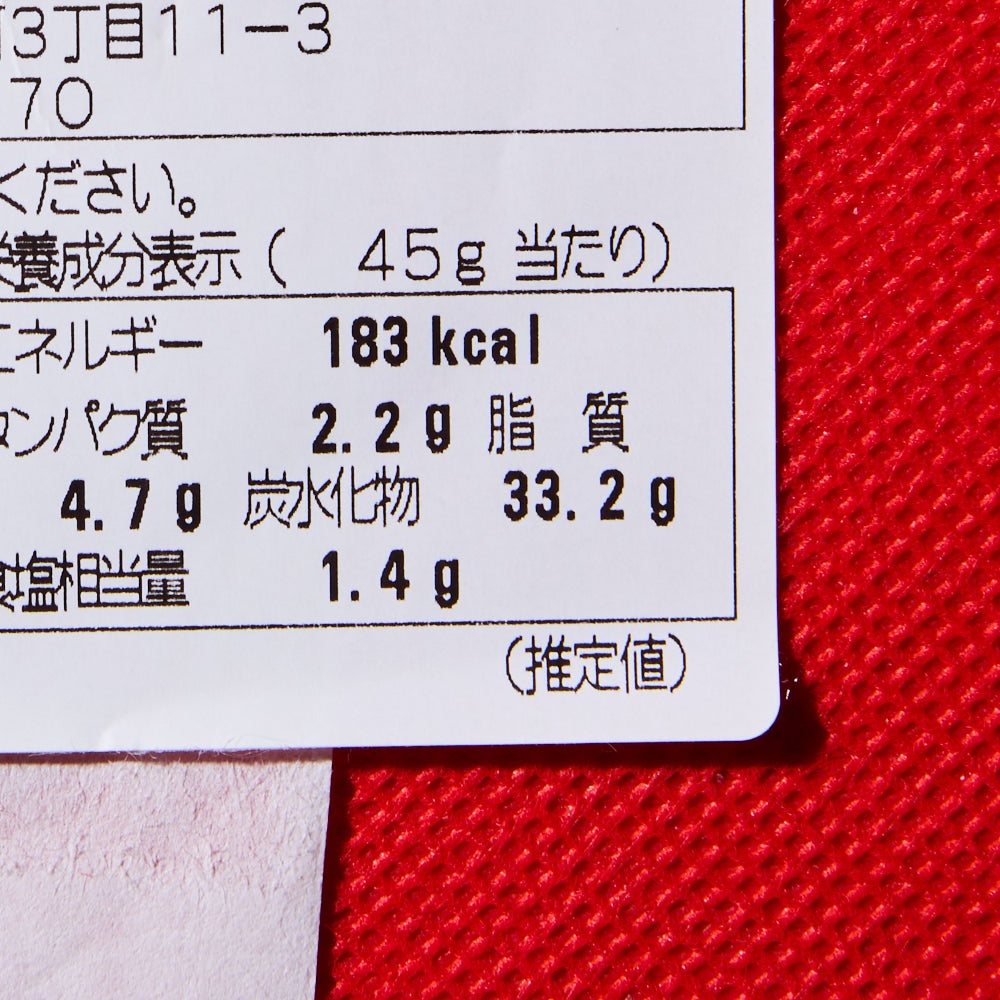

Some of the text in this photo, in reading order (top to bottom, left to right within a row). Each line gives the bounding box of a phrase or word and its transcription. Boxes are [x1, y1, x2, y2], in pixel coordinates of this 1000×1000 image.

[324, 316, 407, 368] 183
[432, 314, 538, 365] kcal
[244, 465, 419, 529] 炭水化物
[506, 633, 686, 695] （推定値）
